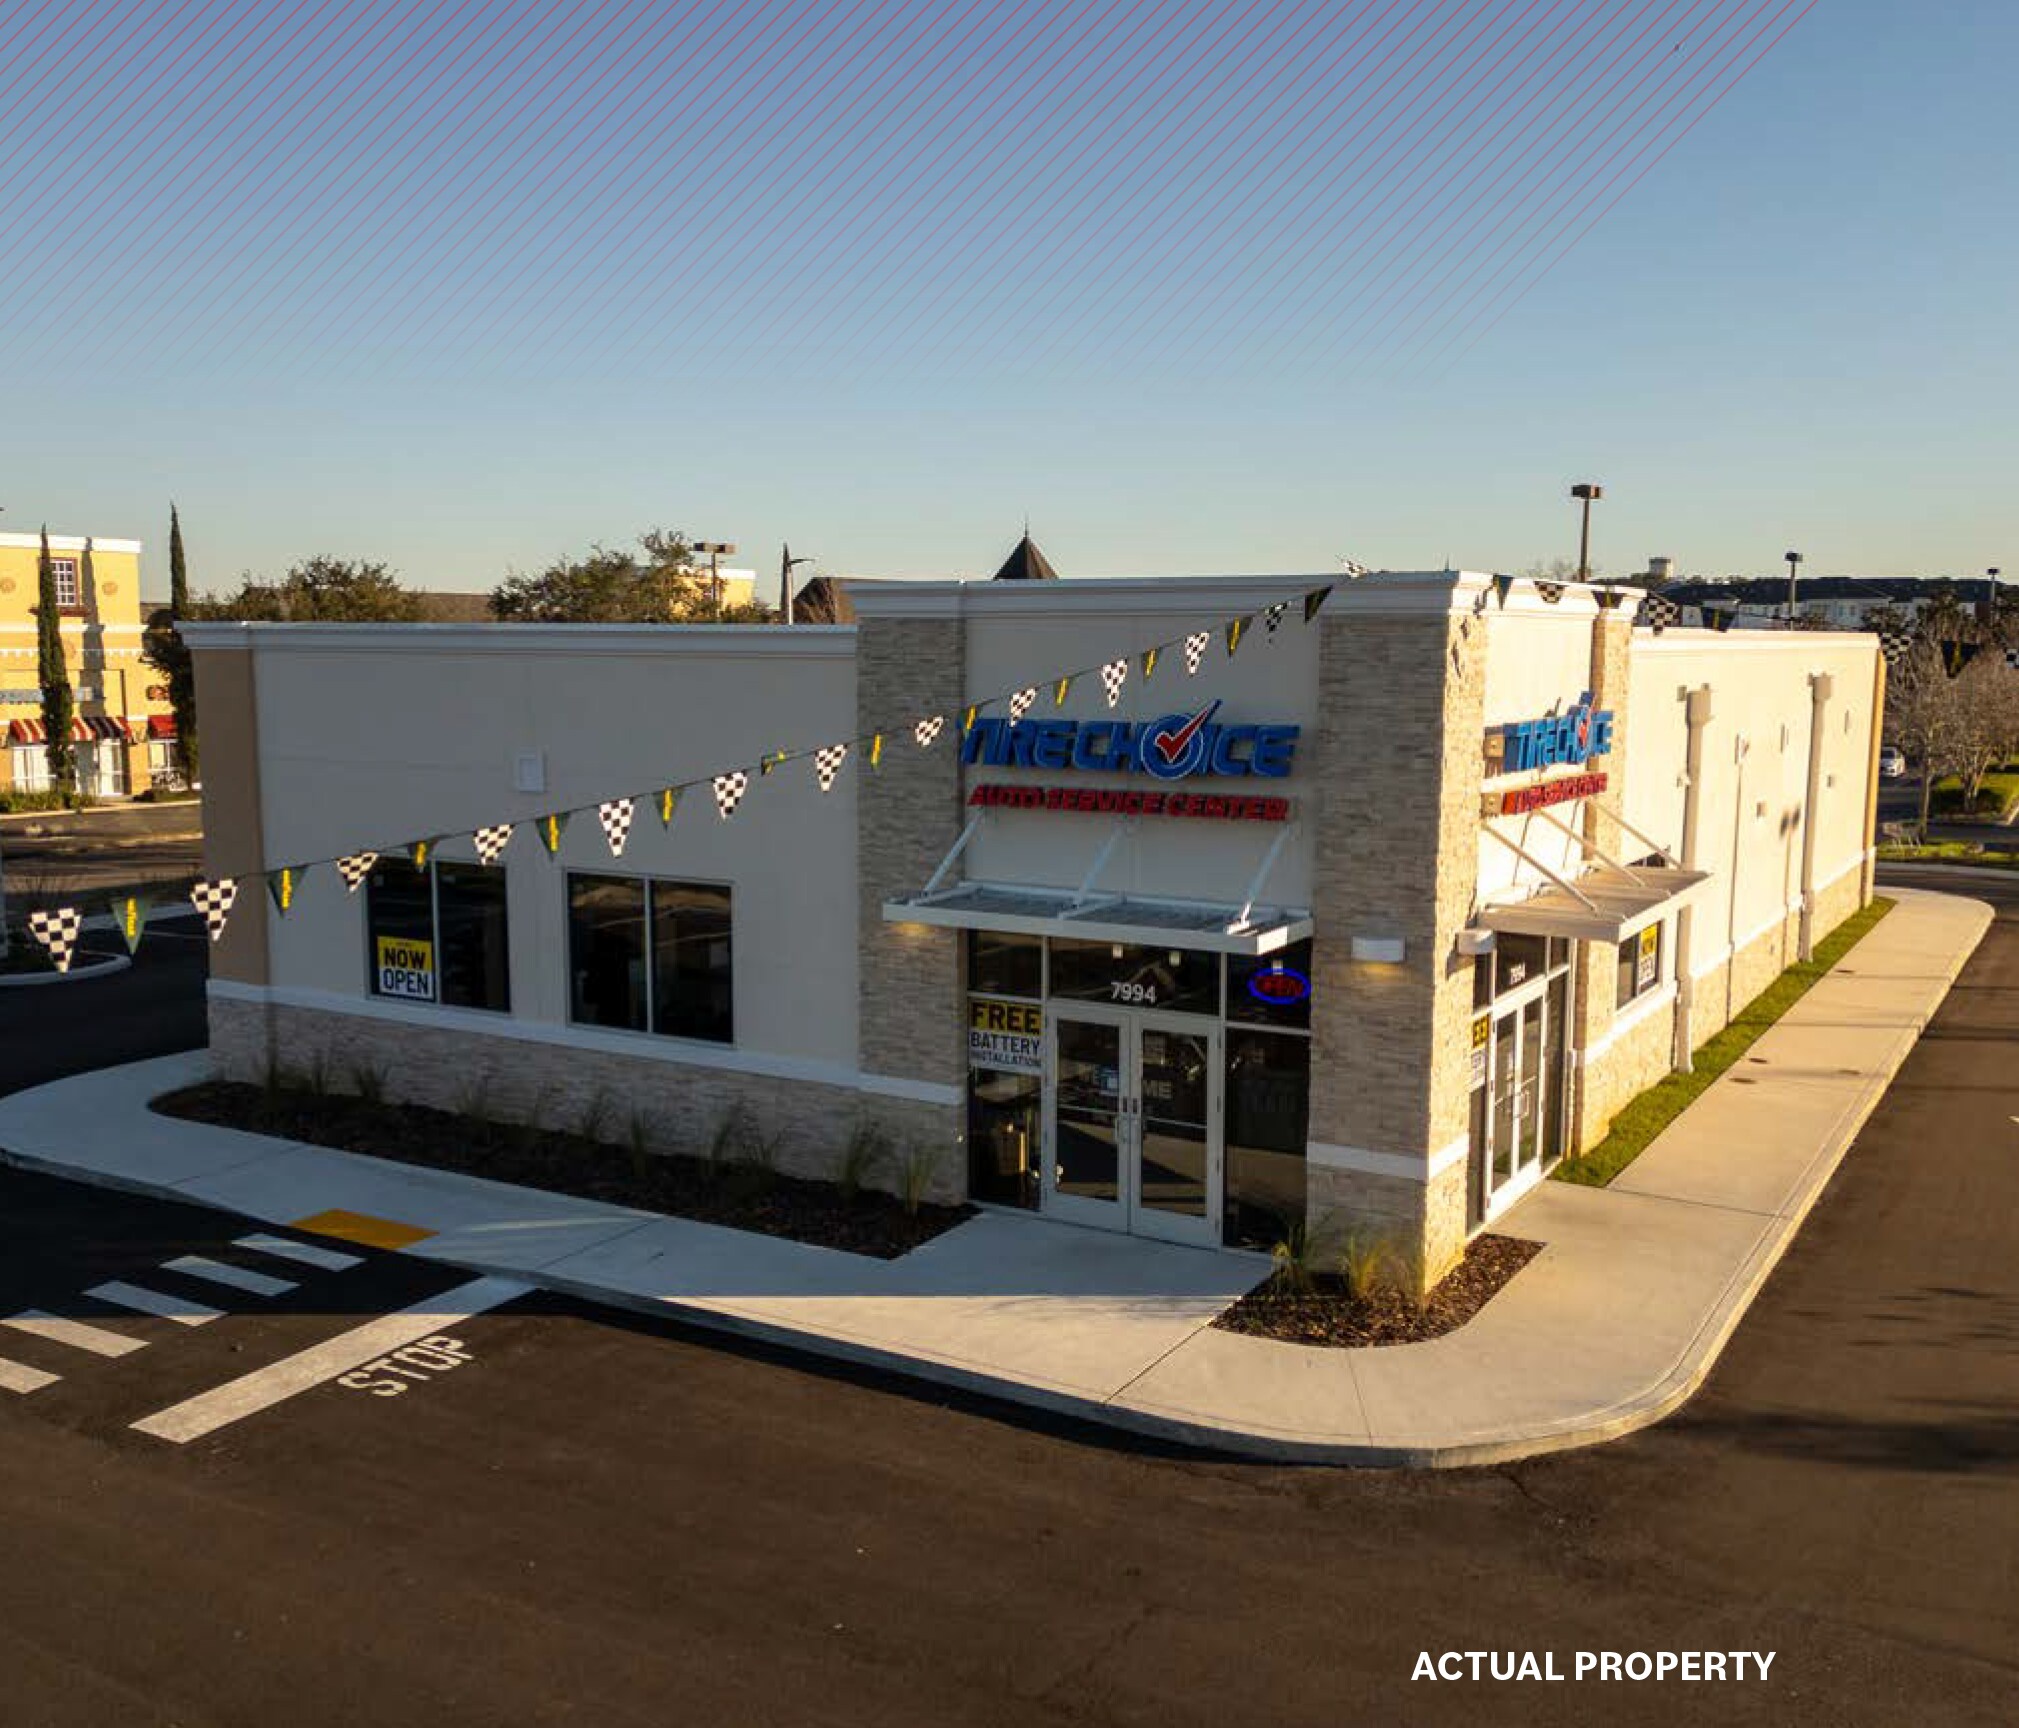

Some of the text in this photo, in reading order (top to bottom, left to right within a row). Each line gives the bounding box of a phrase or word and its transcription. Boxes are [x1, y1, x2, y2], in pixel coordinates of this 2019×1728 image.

[968, 785, 1290, 822] AUTO SERVICE CENTER
[384, 947, 427, 969] NOW
[383, 968, 428, 995] OPEN
[1111, 982, 1156, 1004] 7994
[972, 1002, 1041, 1034] FREE
[970, 1031, 1041, 1055] BATTERY
[337, 1335, 474, 1397] STOP
